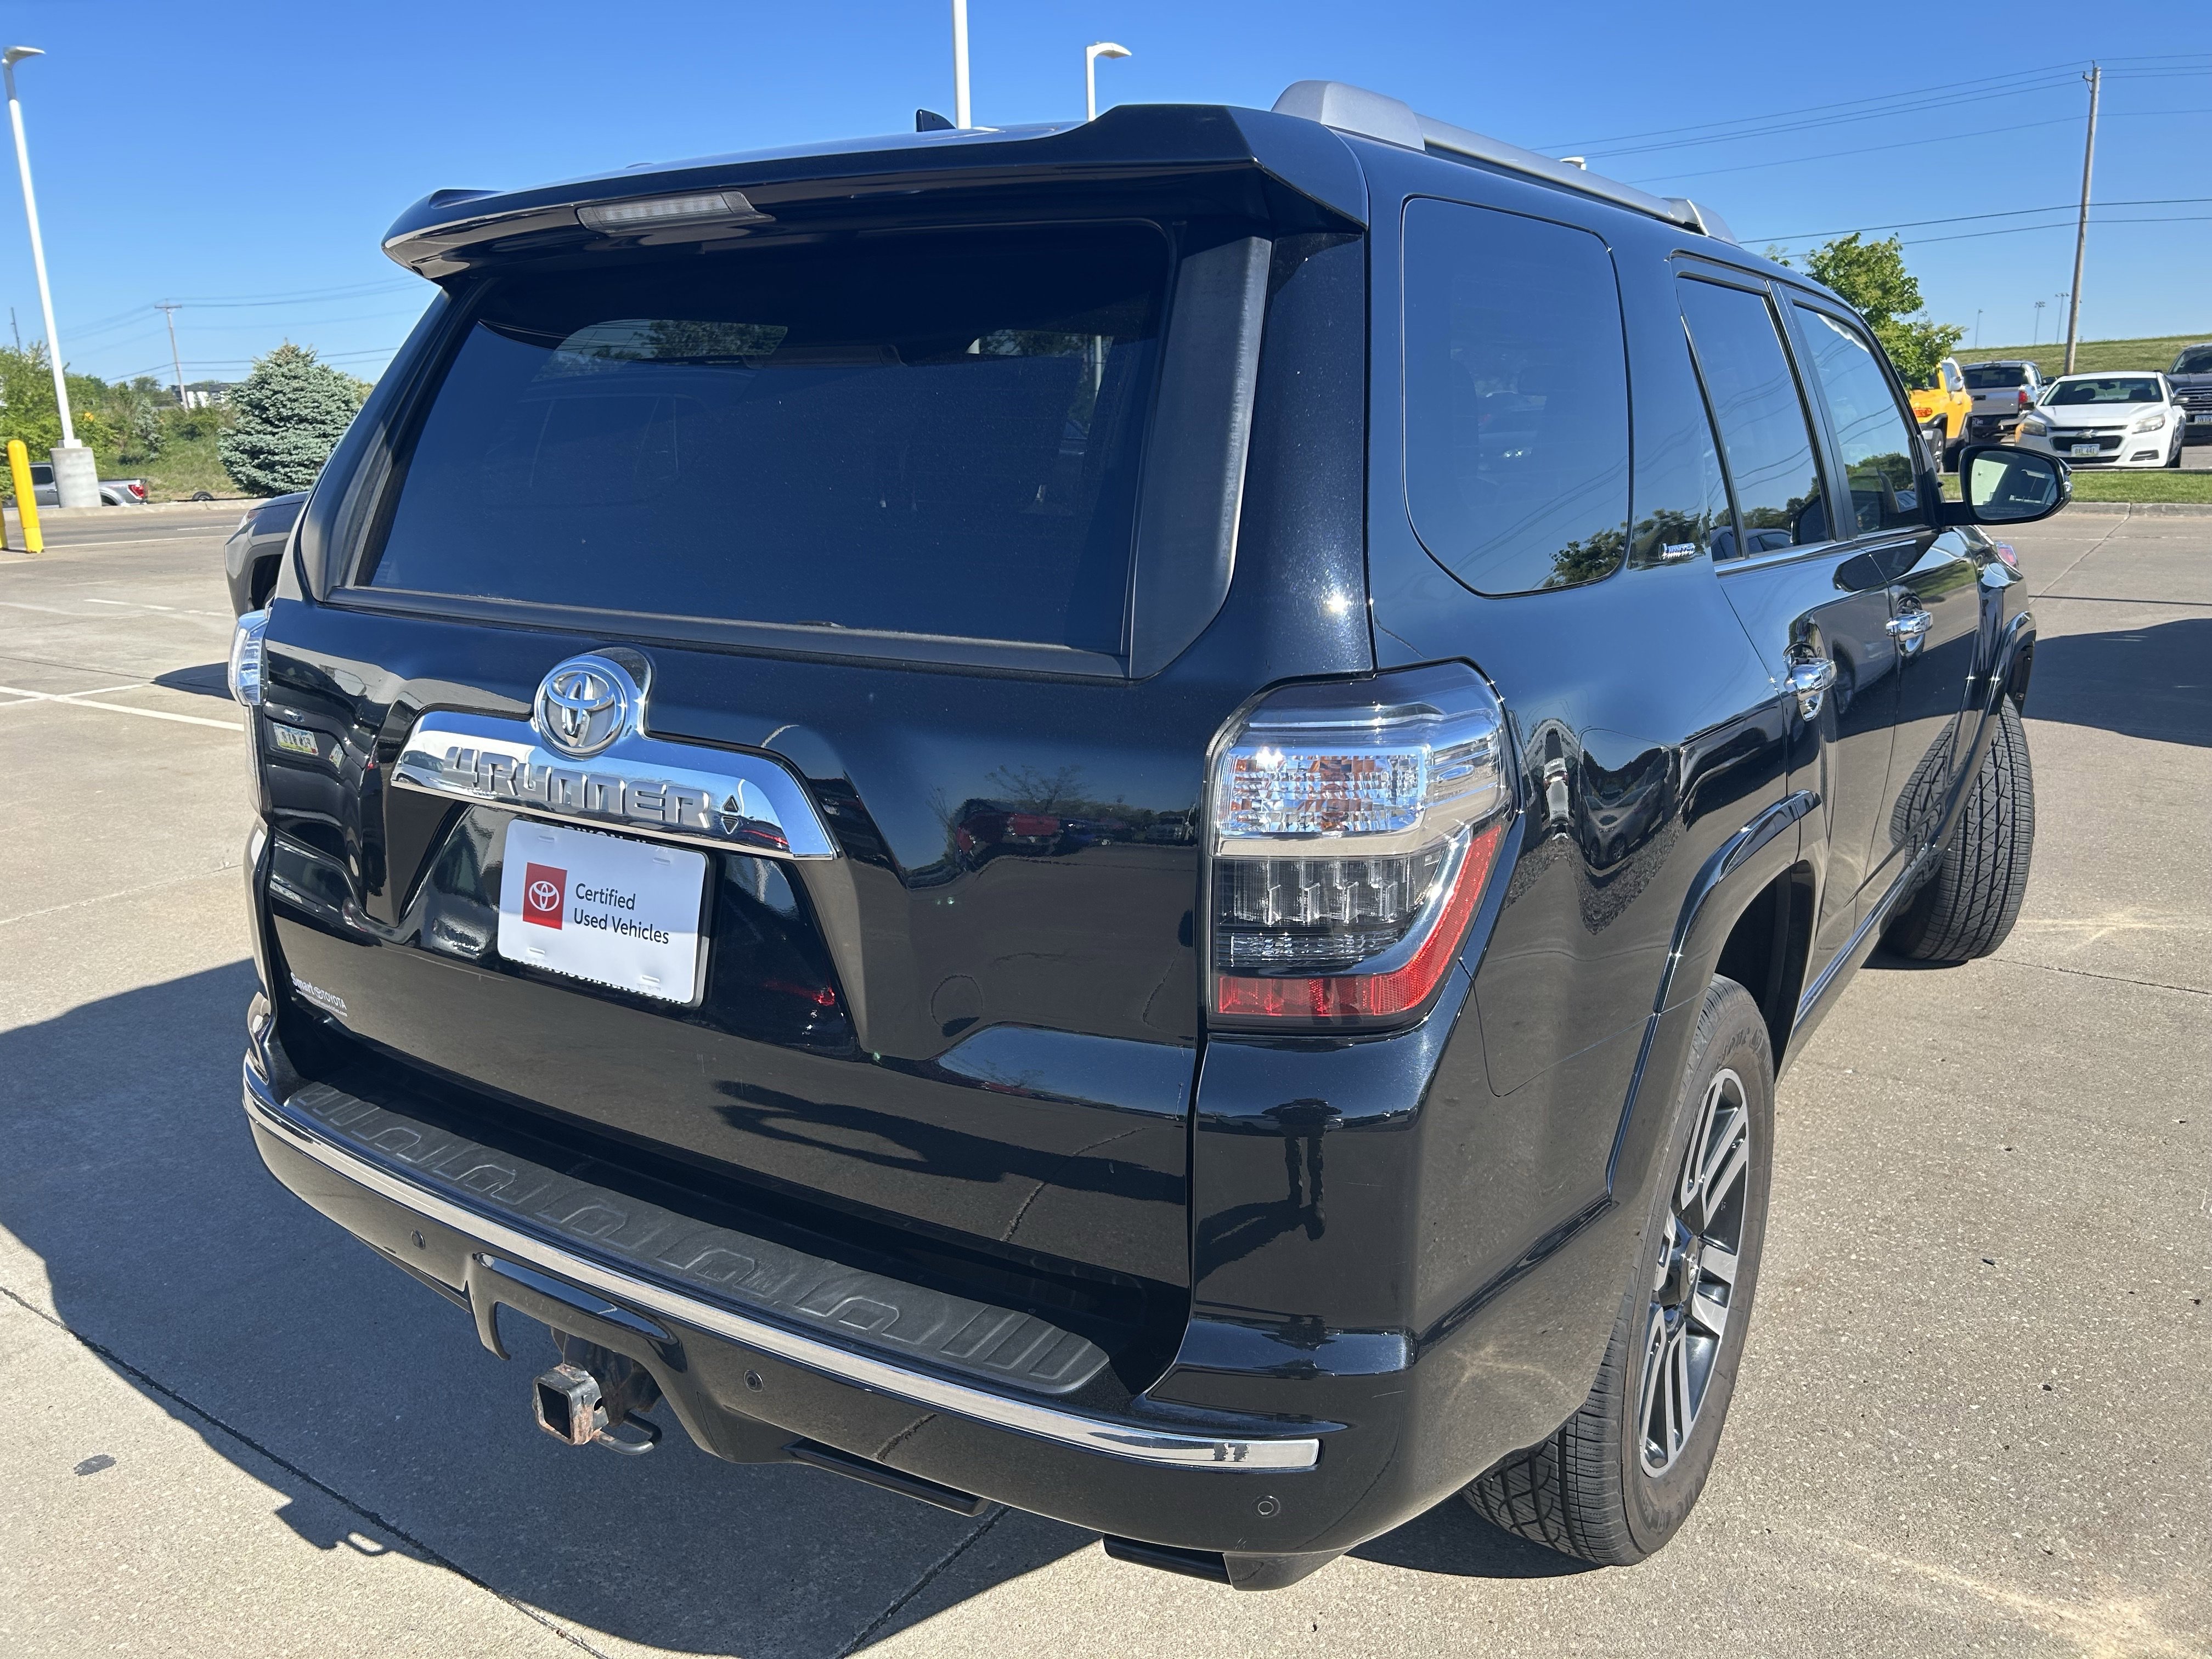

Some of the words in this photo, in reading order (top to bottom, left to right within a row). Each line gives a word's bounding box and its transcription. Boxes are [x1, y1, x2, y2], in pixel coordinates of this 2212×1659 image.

[575, 883, 636, 911] Certified
[574, 908, 608, 931] Used
[612, 916, 669, 945] Vehicles
[290, 972, 315, 996] Smart
[320, 989, 347, 1011] TOYOTA
